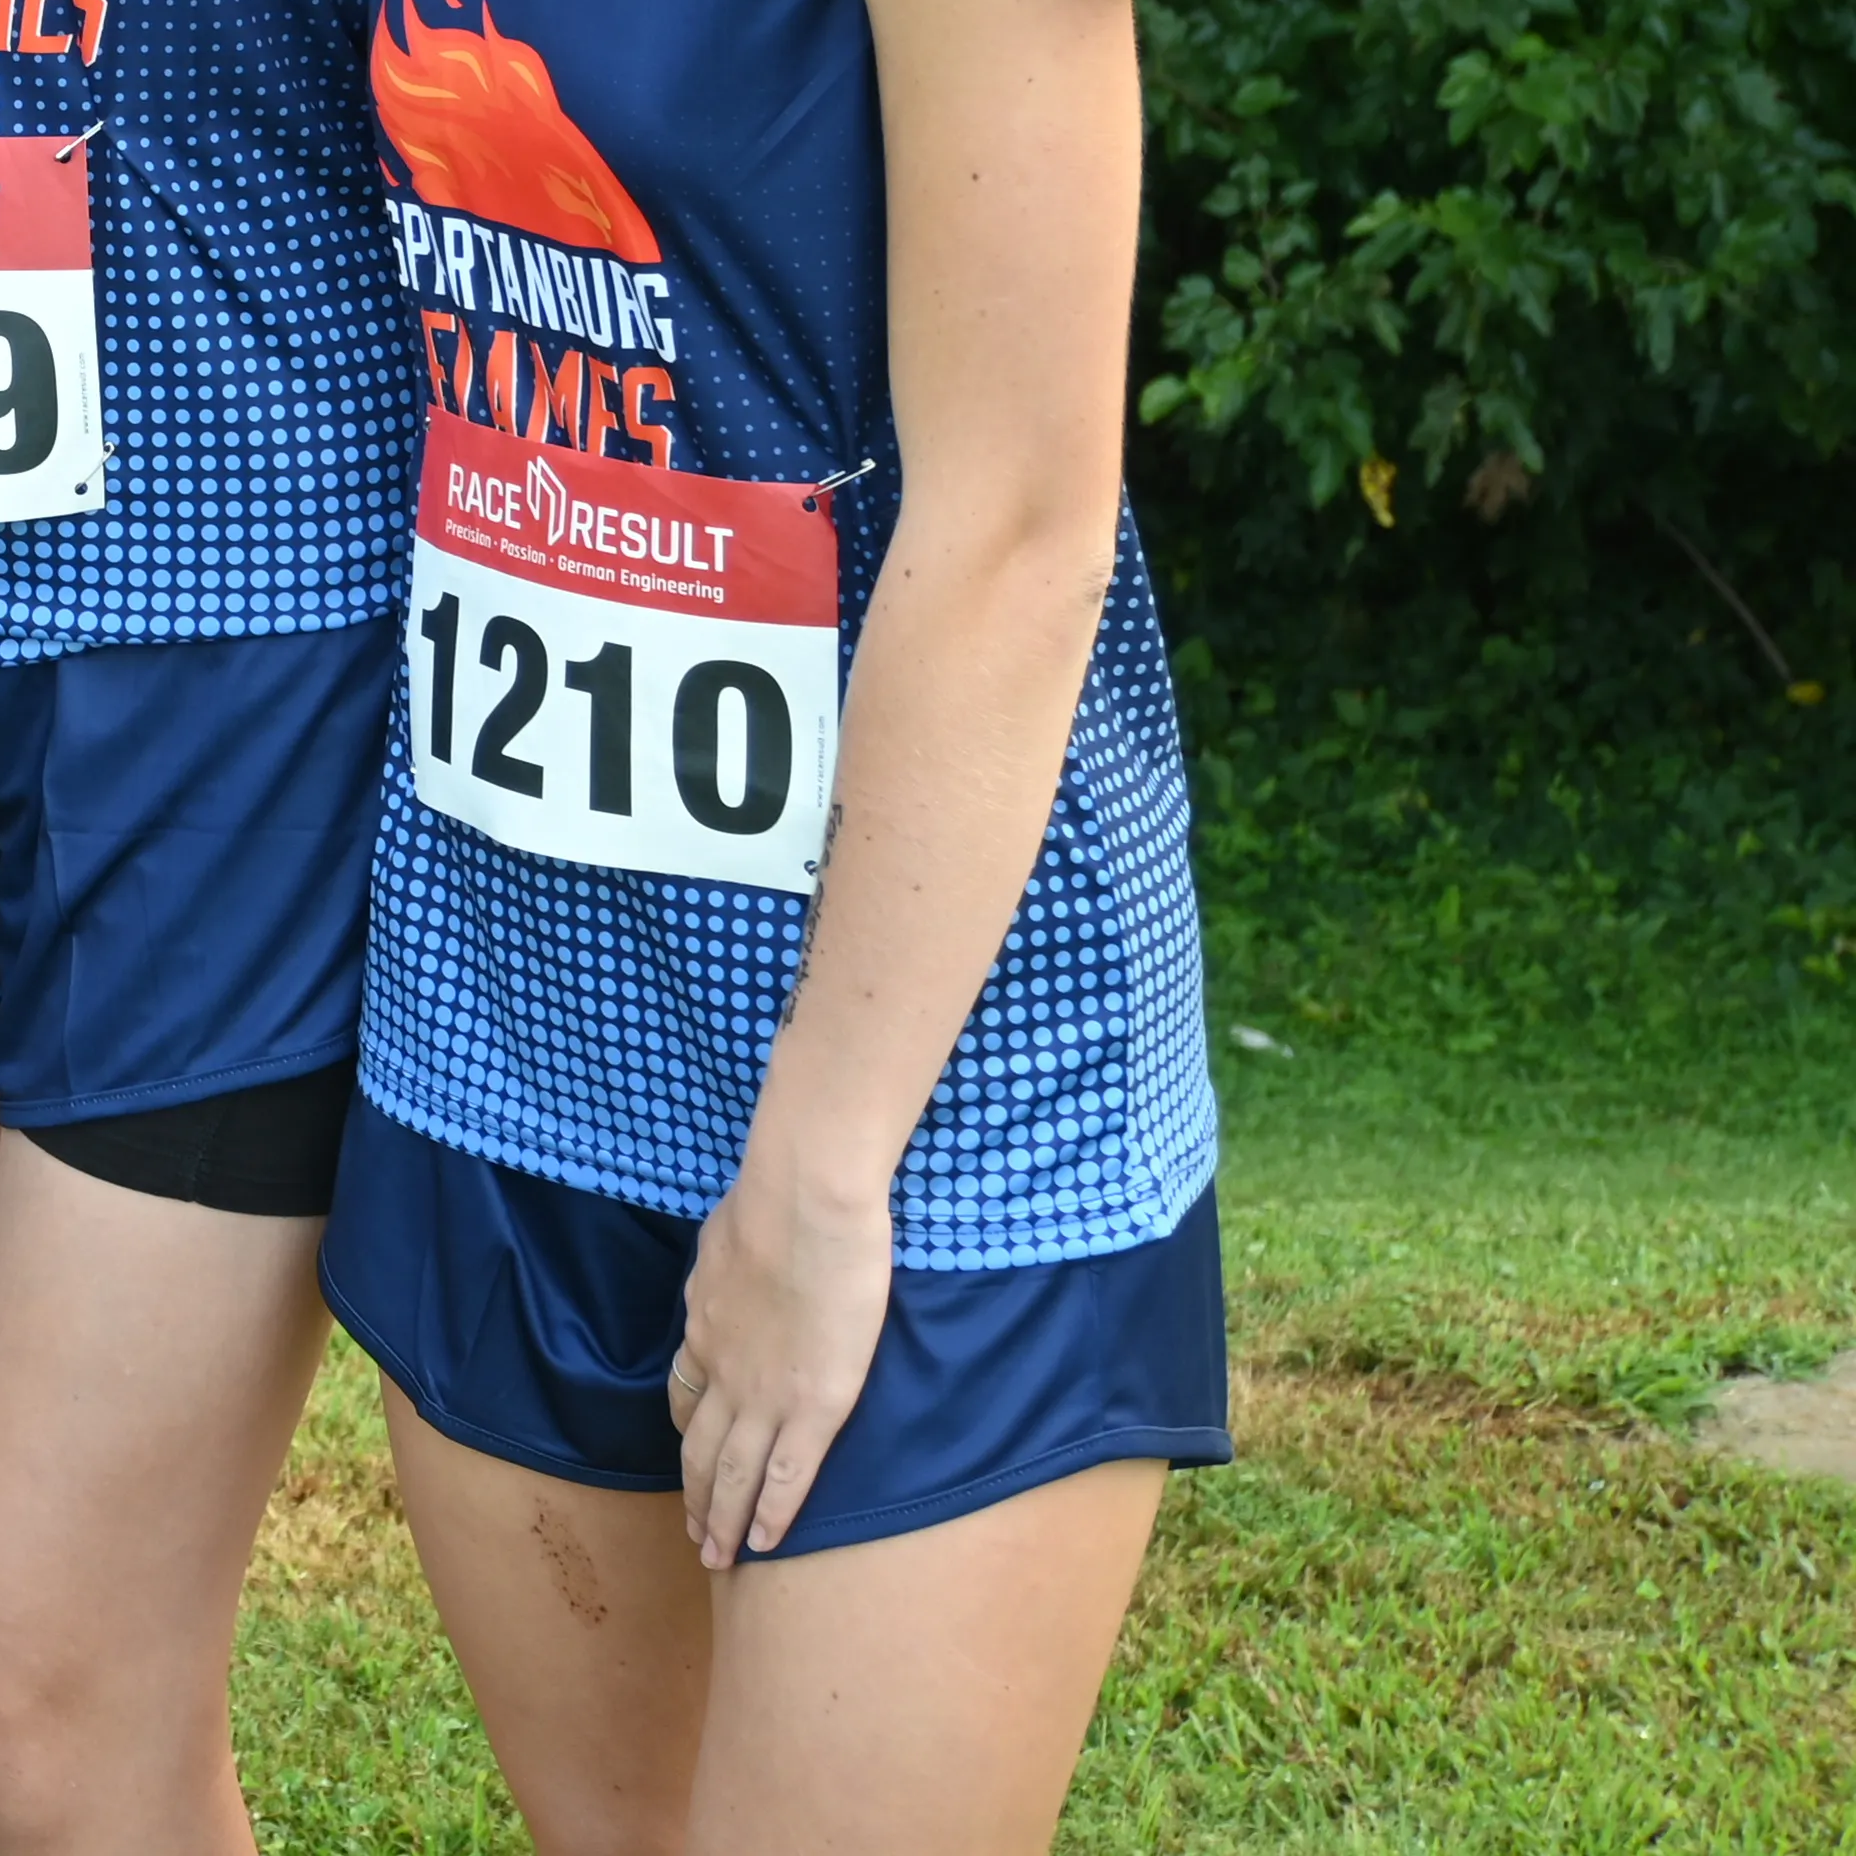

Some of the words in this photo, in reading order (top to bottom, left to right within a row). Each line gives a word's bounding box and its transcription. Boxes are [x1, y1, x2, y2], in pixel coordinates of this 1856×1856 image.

[385, 198, 676, 363] SPARTANBURG
[445, 519, 491, 548] Precision
[500, 537, 546, 566] Passion
[558, 555, 615, 582] German
[620, 569, 725, 604] Engineering
[447, 463, 522, 530] RACE
[569, 500, 734, 573] RESULT
[420, 591, 793, 835] 1210
